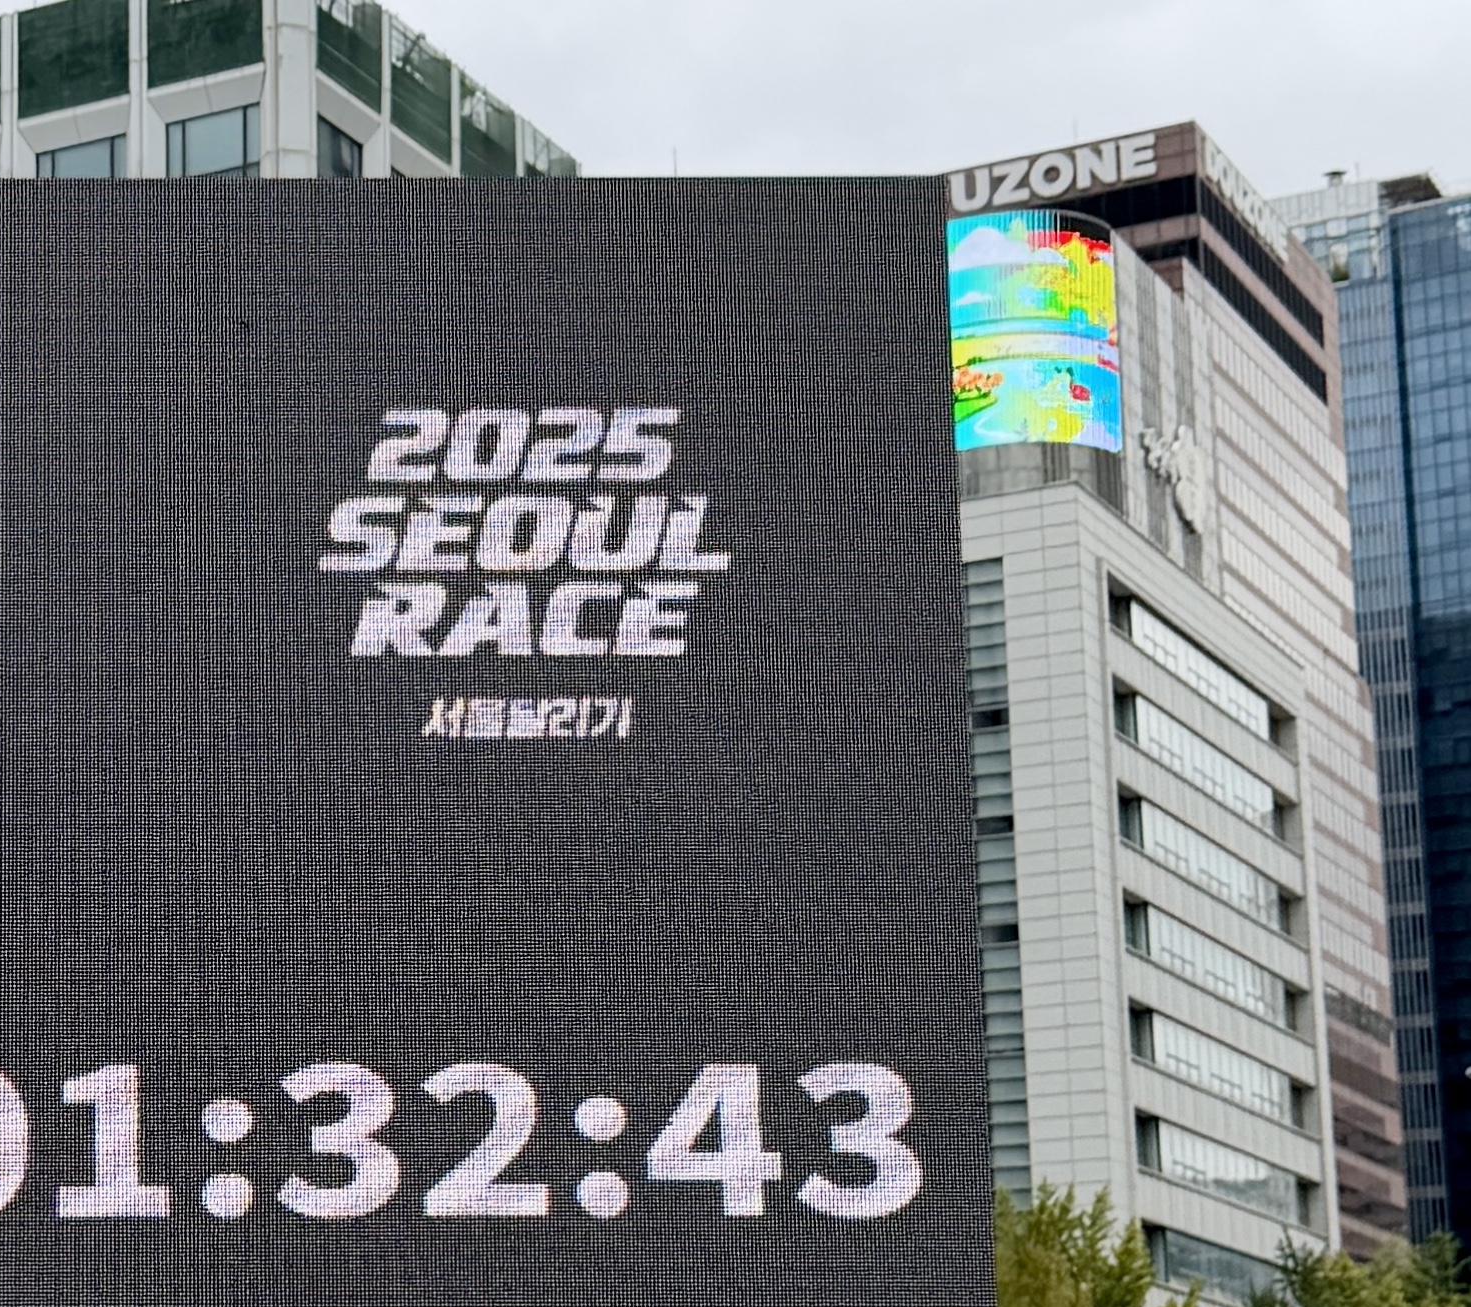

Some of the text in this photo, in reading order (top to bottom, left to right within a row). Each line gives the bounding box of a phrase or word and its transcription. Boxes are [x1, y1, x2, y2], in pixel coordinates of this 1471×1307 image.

[950, 132, 1158, 213] UZONE
[367, 406, 682, 482] 2025
[318, 495, 729, 571] SEOUL
[350, 580, 699, 658] RACE
